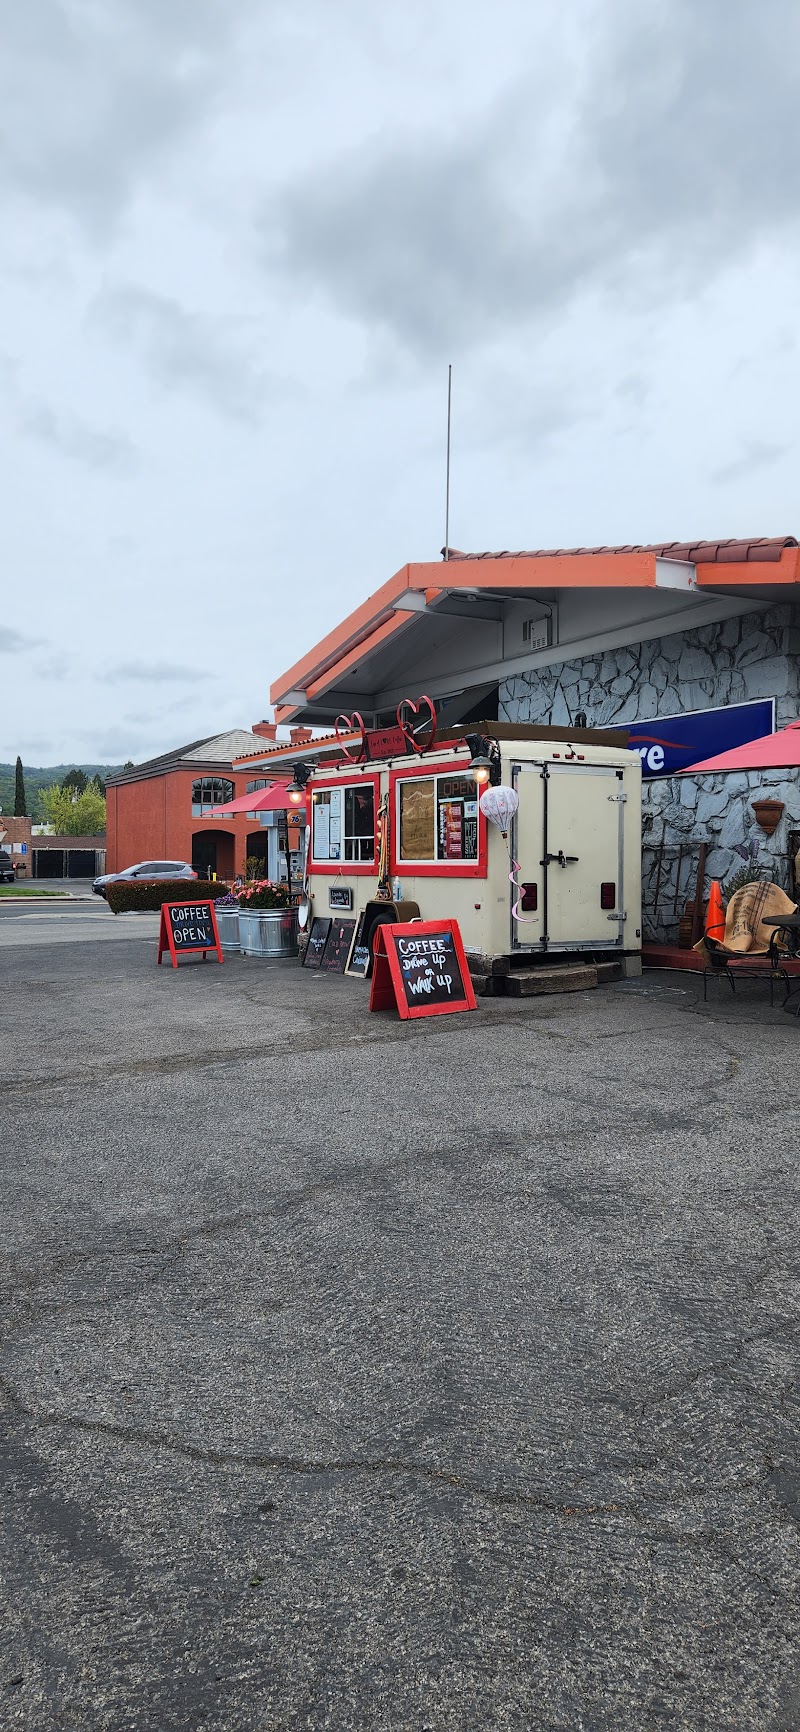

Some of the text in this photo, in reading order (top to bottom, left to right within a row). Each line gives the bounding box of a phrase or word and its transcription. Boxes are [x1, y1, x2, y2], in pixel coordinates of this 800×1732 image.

[443, 781, 475, 796] OPEN
[291, 815, 300, 823] 76
[171, 907, 209, 922] COFFEE
[173, 926, 206, 943] OPEN
[398, 938, 446, 954] COFFEE
[408, 976, 435, 995] WALK
